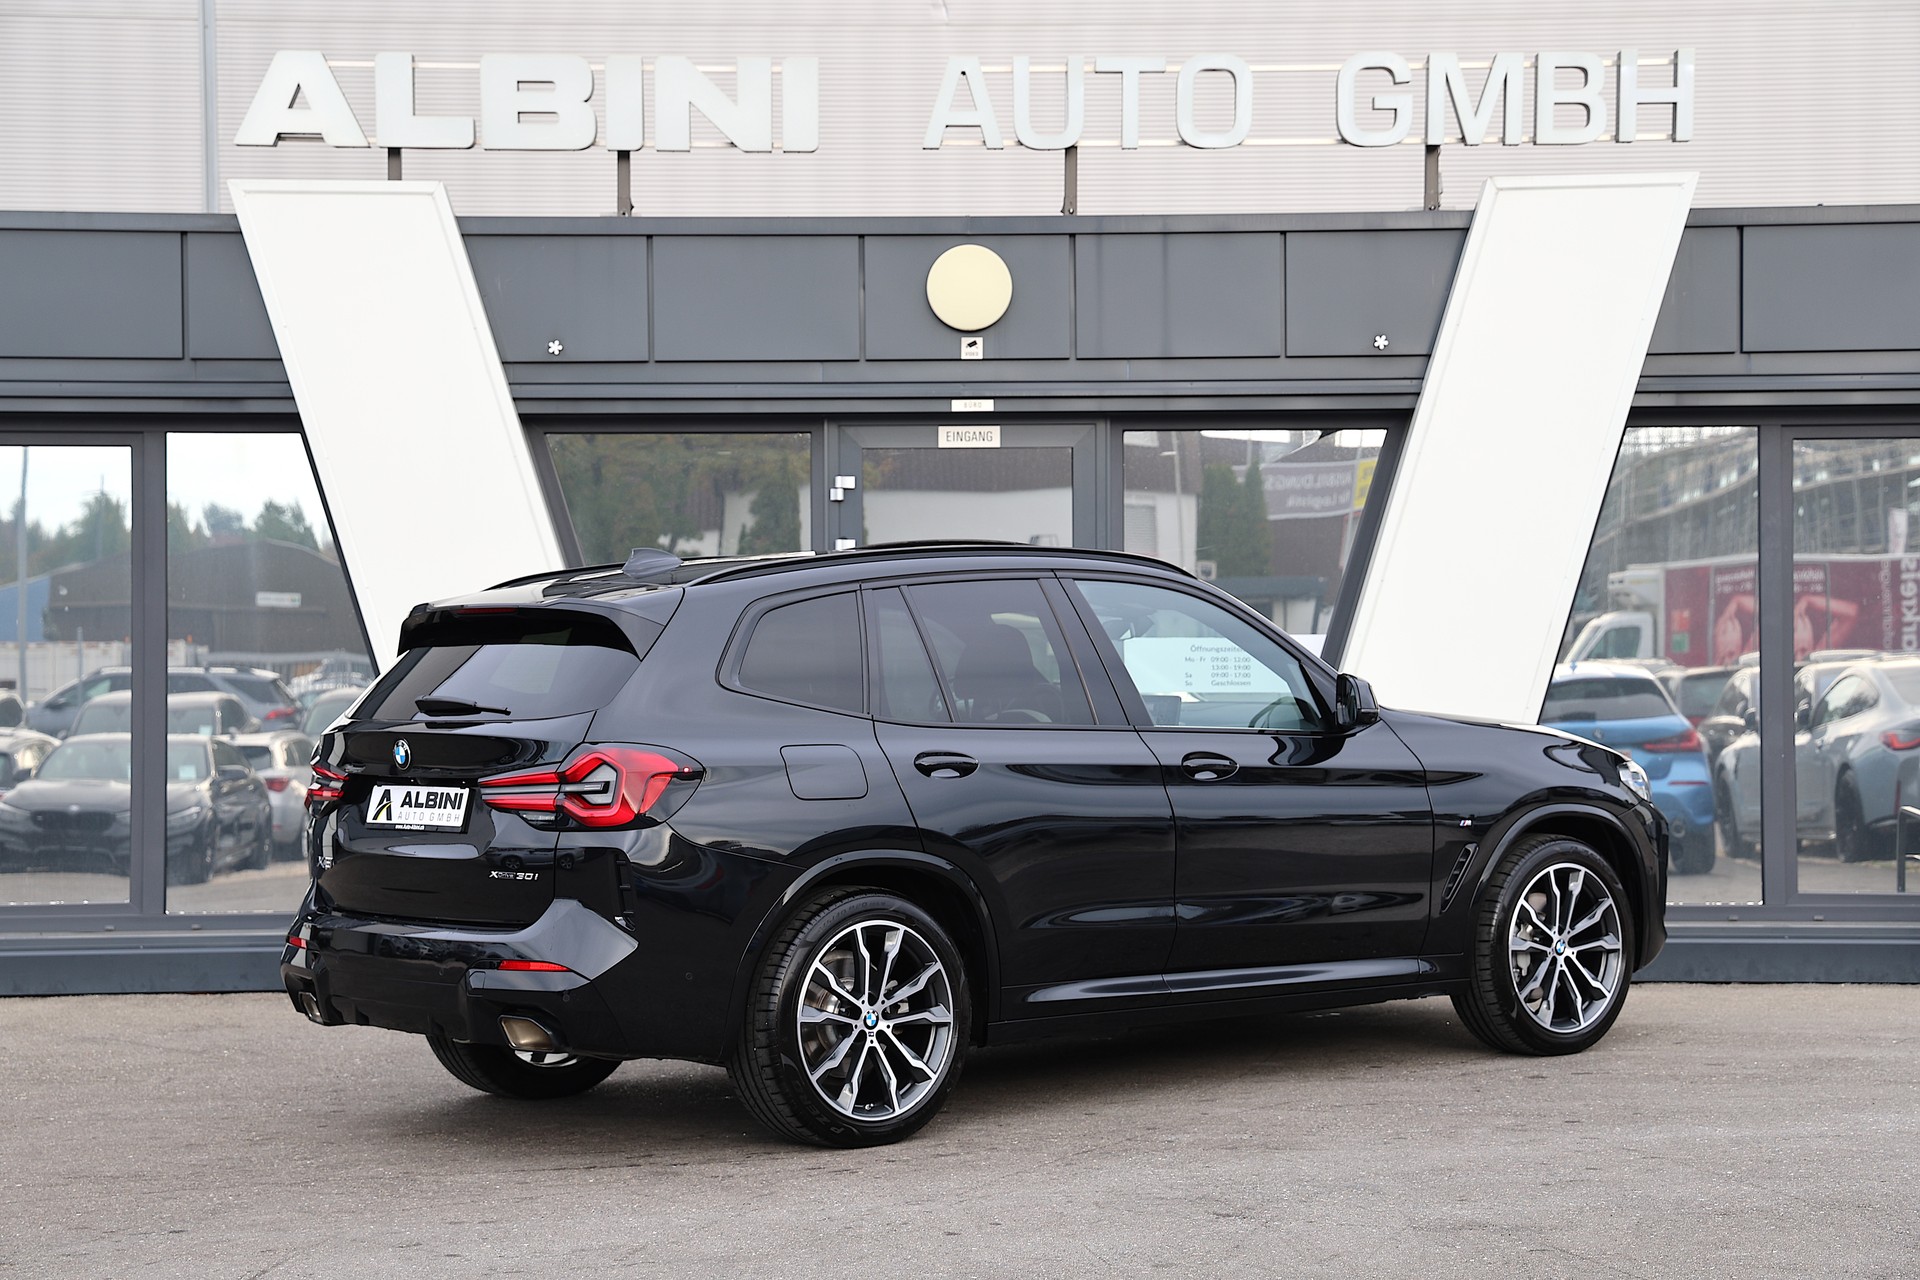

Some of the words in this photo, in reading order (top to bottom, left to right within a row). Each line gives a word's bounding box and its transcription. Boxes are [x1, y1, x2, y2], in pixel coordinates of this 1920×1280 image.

[233, 50, 820, 154] ALBINI
[922, 51, 1254, 151] AUTO
[1335, 46, 1696, 147] GMBH
[946, 430, 993, 443] EINGANG
[400, 790, 464, 810] ALBINI
[397, 811, 425, 821] AUTO
[428, 812, 460, 823] GMBH
